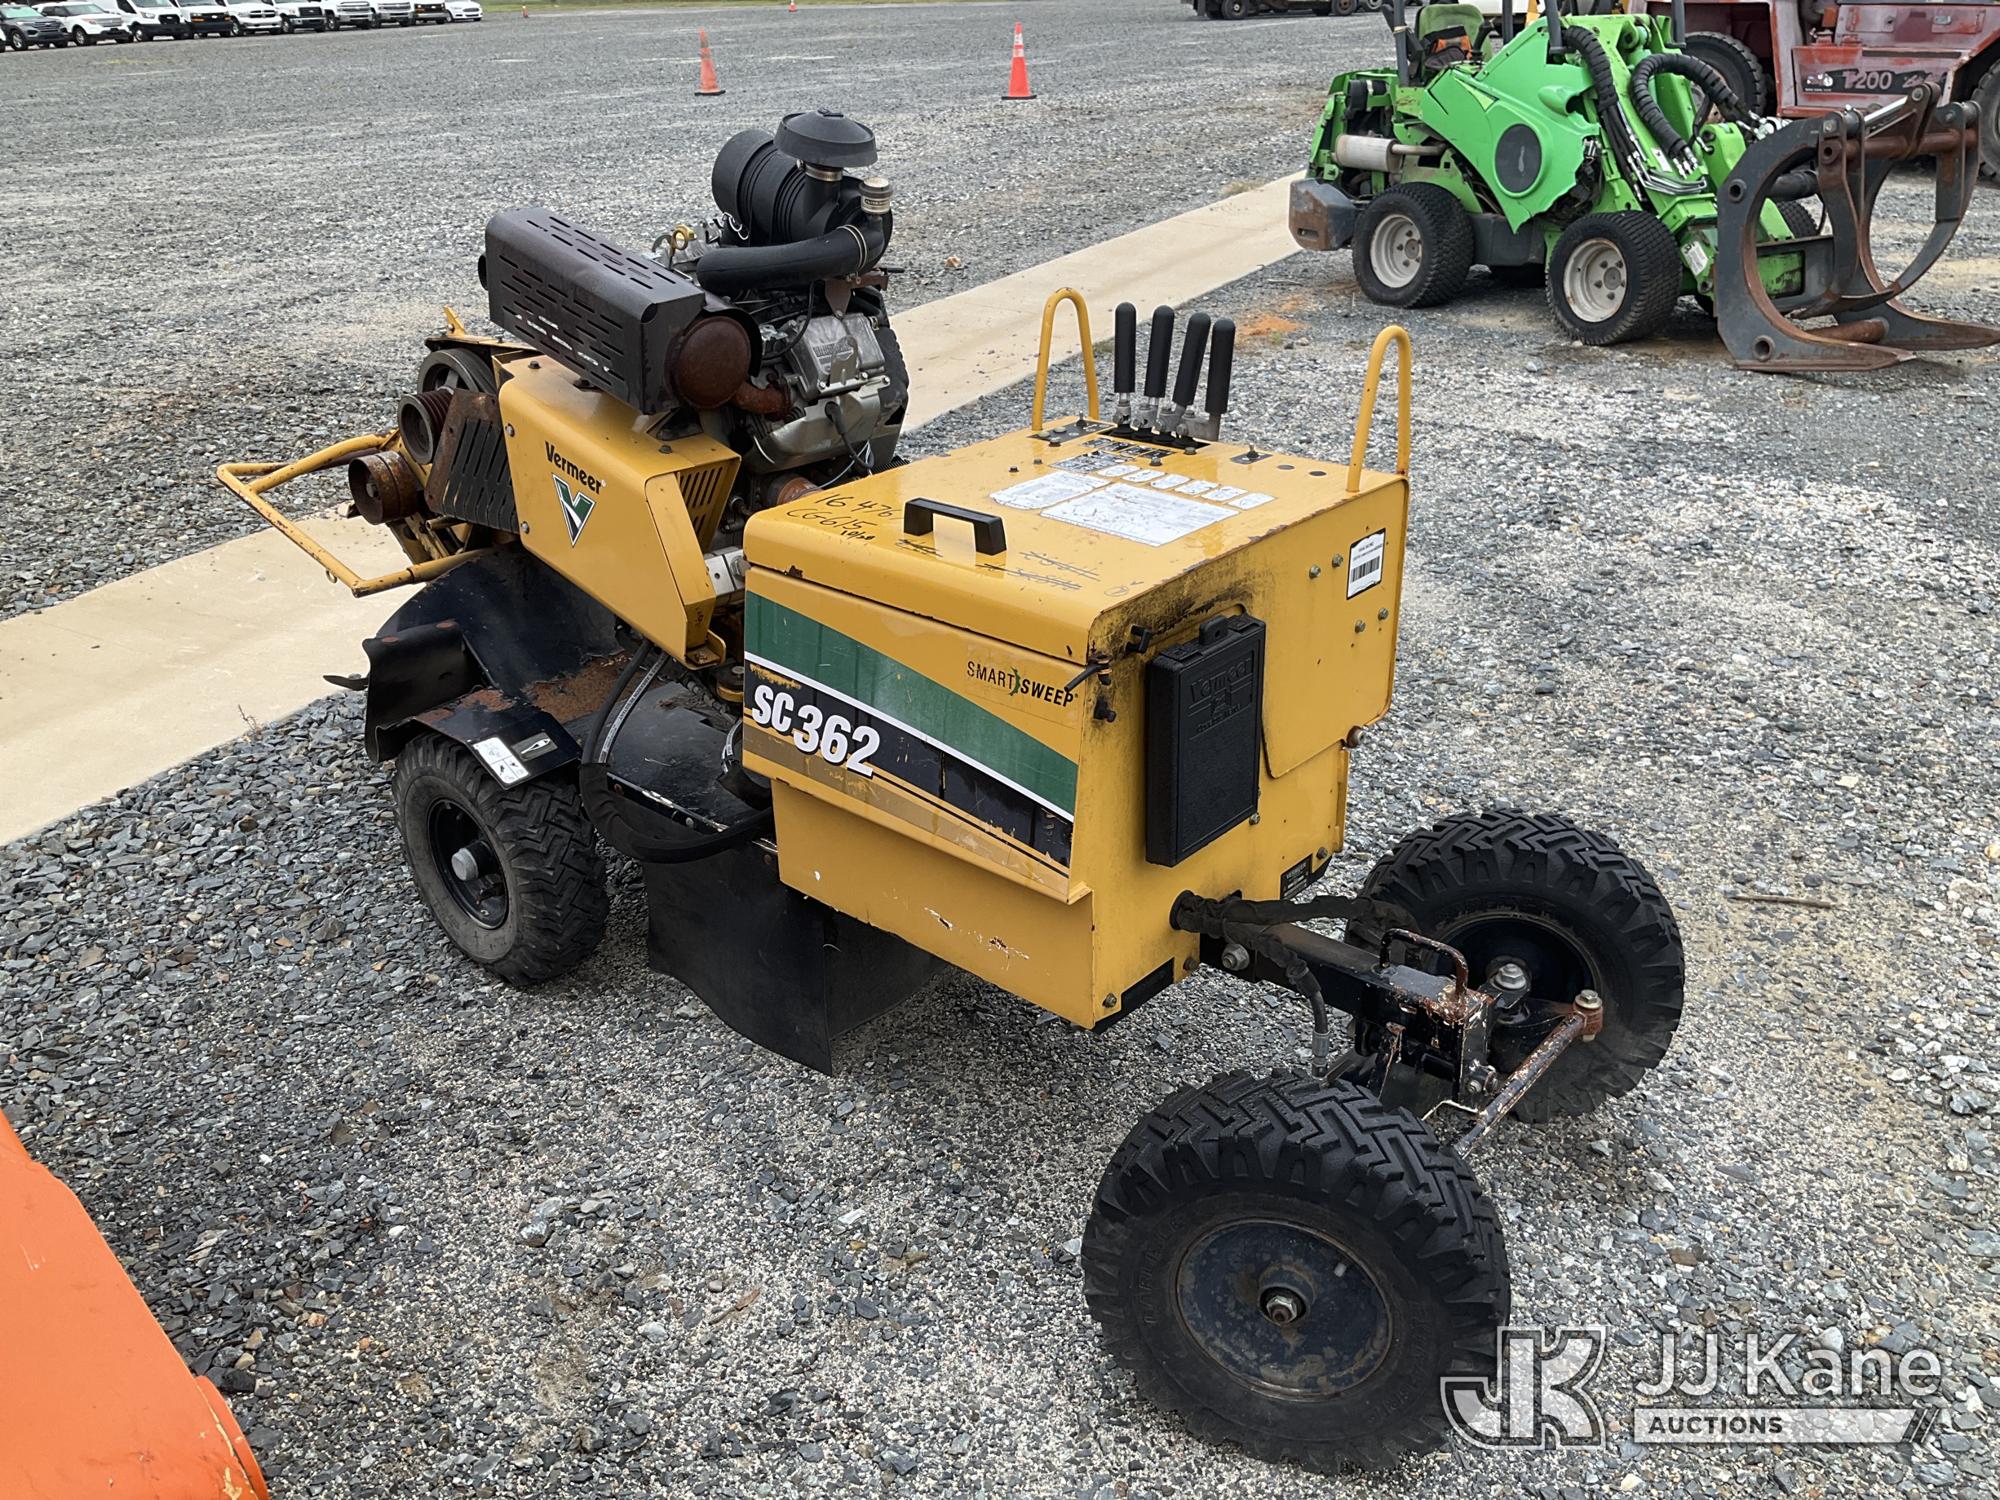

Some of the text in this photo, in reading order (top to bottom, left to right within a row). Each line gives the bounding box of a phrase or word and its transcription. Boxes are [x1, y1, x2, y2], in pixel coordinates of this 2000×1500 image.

[545, 440, 604, 495] Vermeer
[967, 660, 1074, 707] SMART SWEEP
